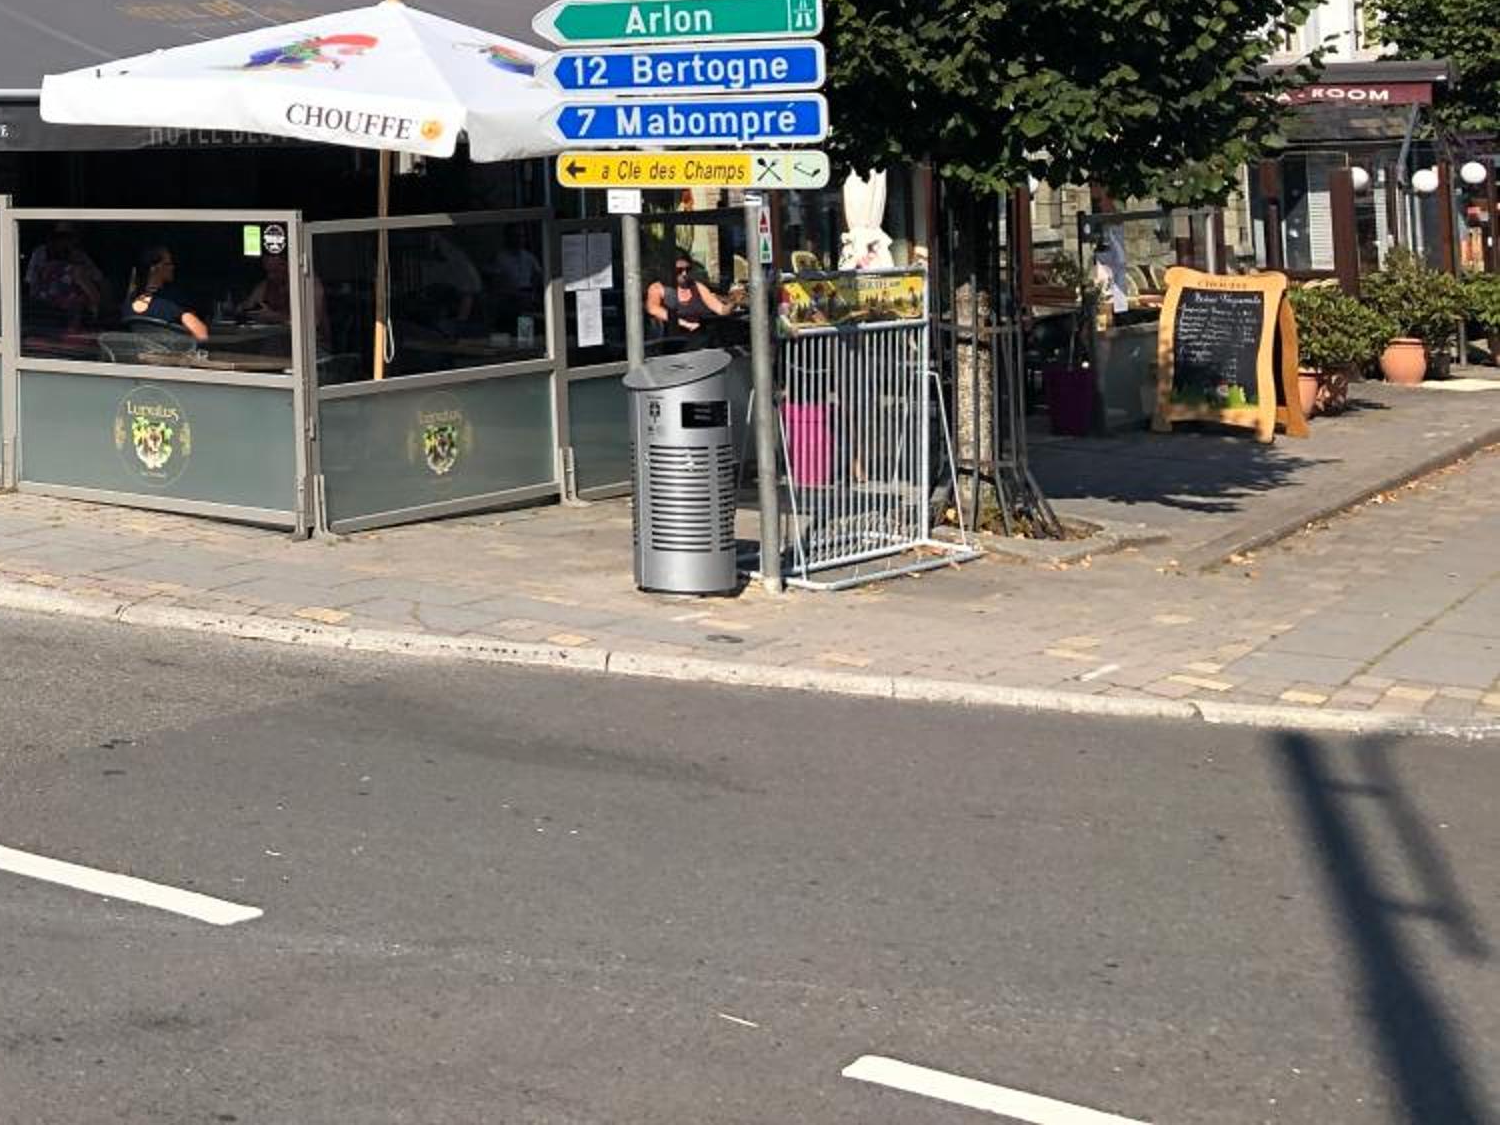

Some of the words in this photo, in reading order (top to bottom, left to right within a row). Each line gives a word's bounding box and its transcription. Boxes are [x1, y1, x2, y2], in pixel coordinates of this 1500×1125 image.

[625, 4, 713, 34] Arlon
[574, 56, 608, 86] 12
[632, 54, 789, 88] Bertogne
[285, 103, 413, 140] CHOUFFE
[577, 108, 596, 137] 7
[616, 102, 797, 141] Mabompré
[649, 160, 676, 180] des
[683, 160, 745, 184] Champs
